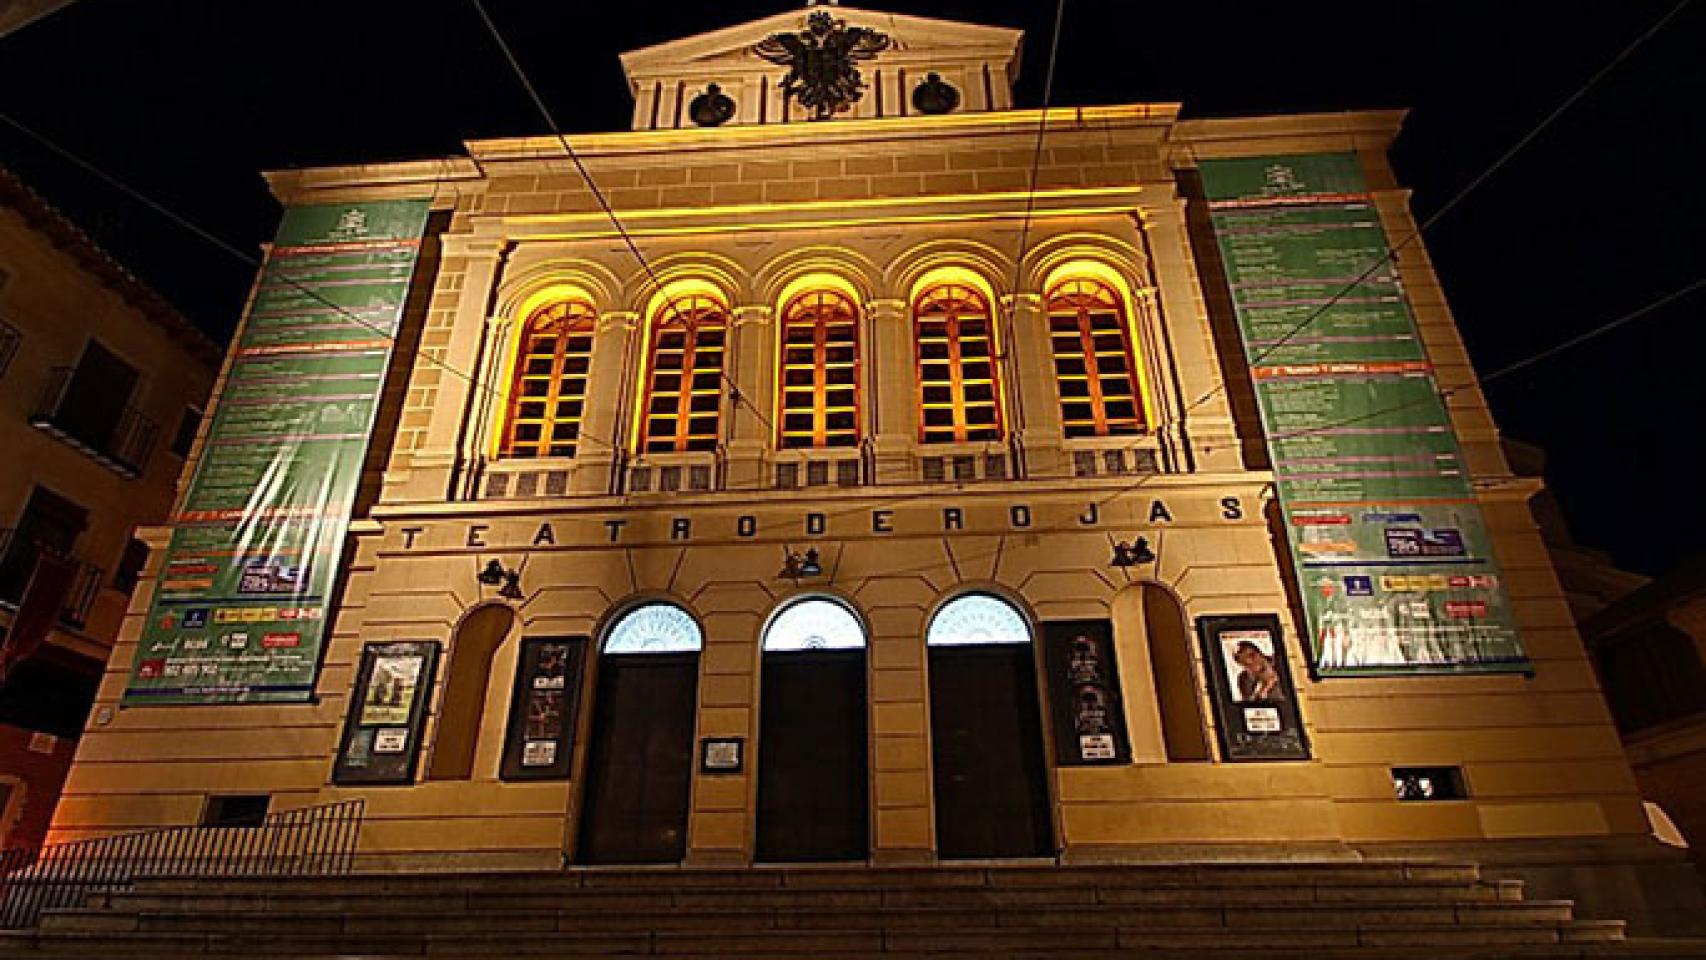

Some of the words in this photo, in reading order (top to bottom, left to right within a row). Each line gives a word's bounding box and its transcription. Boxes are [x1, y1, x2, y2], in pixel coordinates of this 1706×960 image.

[401, 515, 757, 549] TEATRO
[807, 511, 894, 536] DE
[944, 497, 1242, 530] ROJAS
